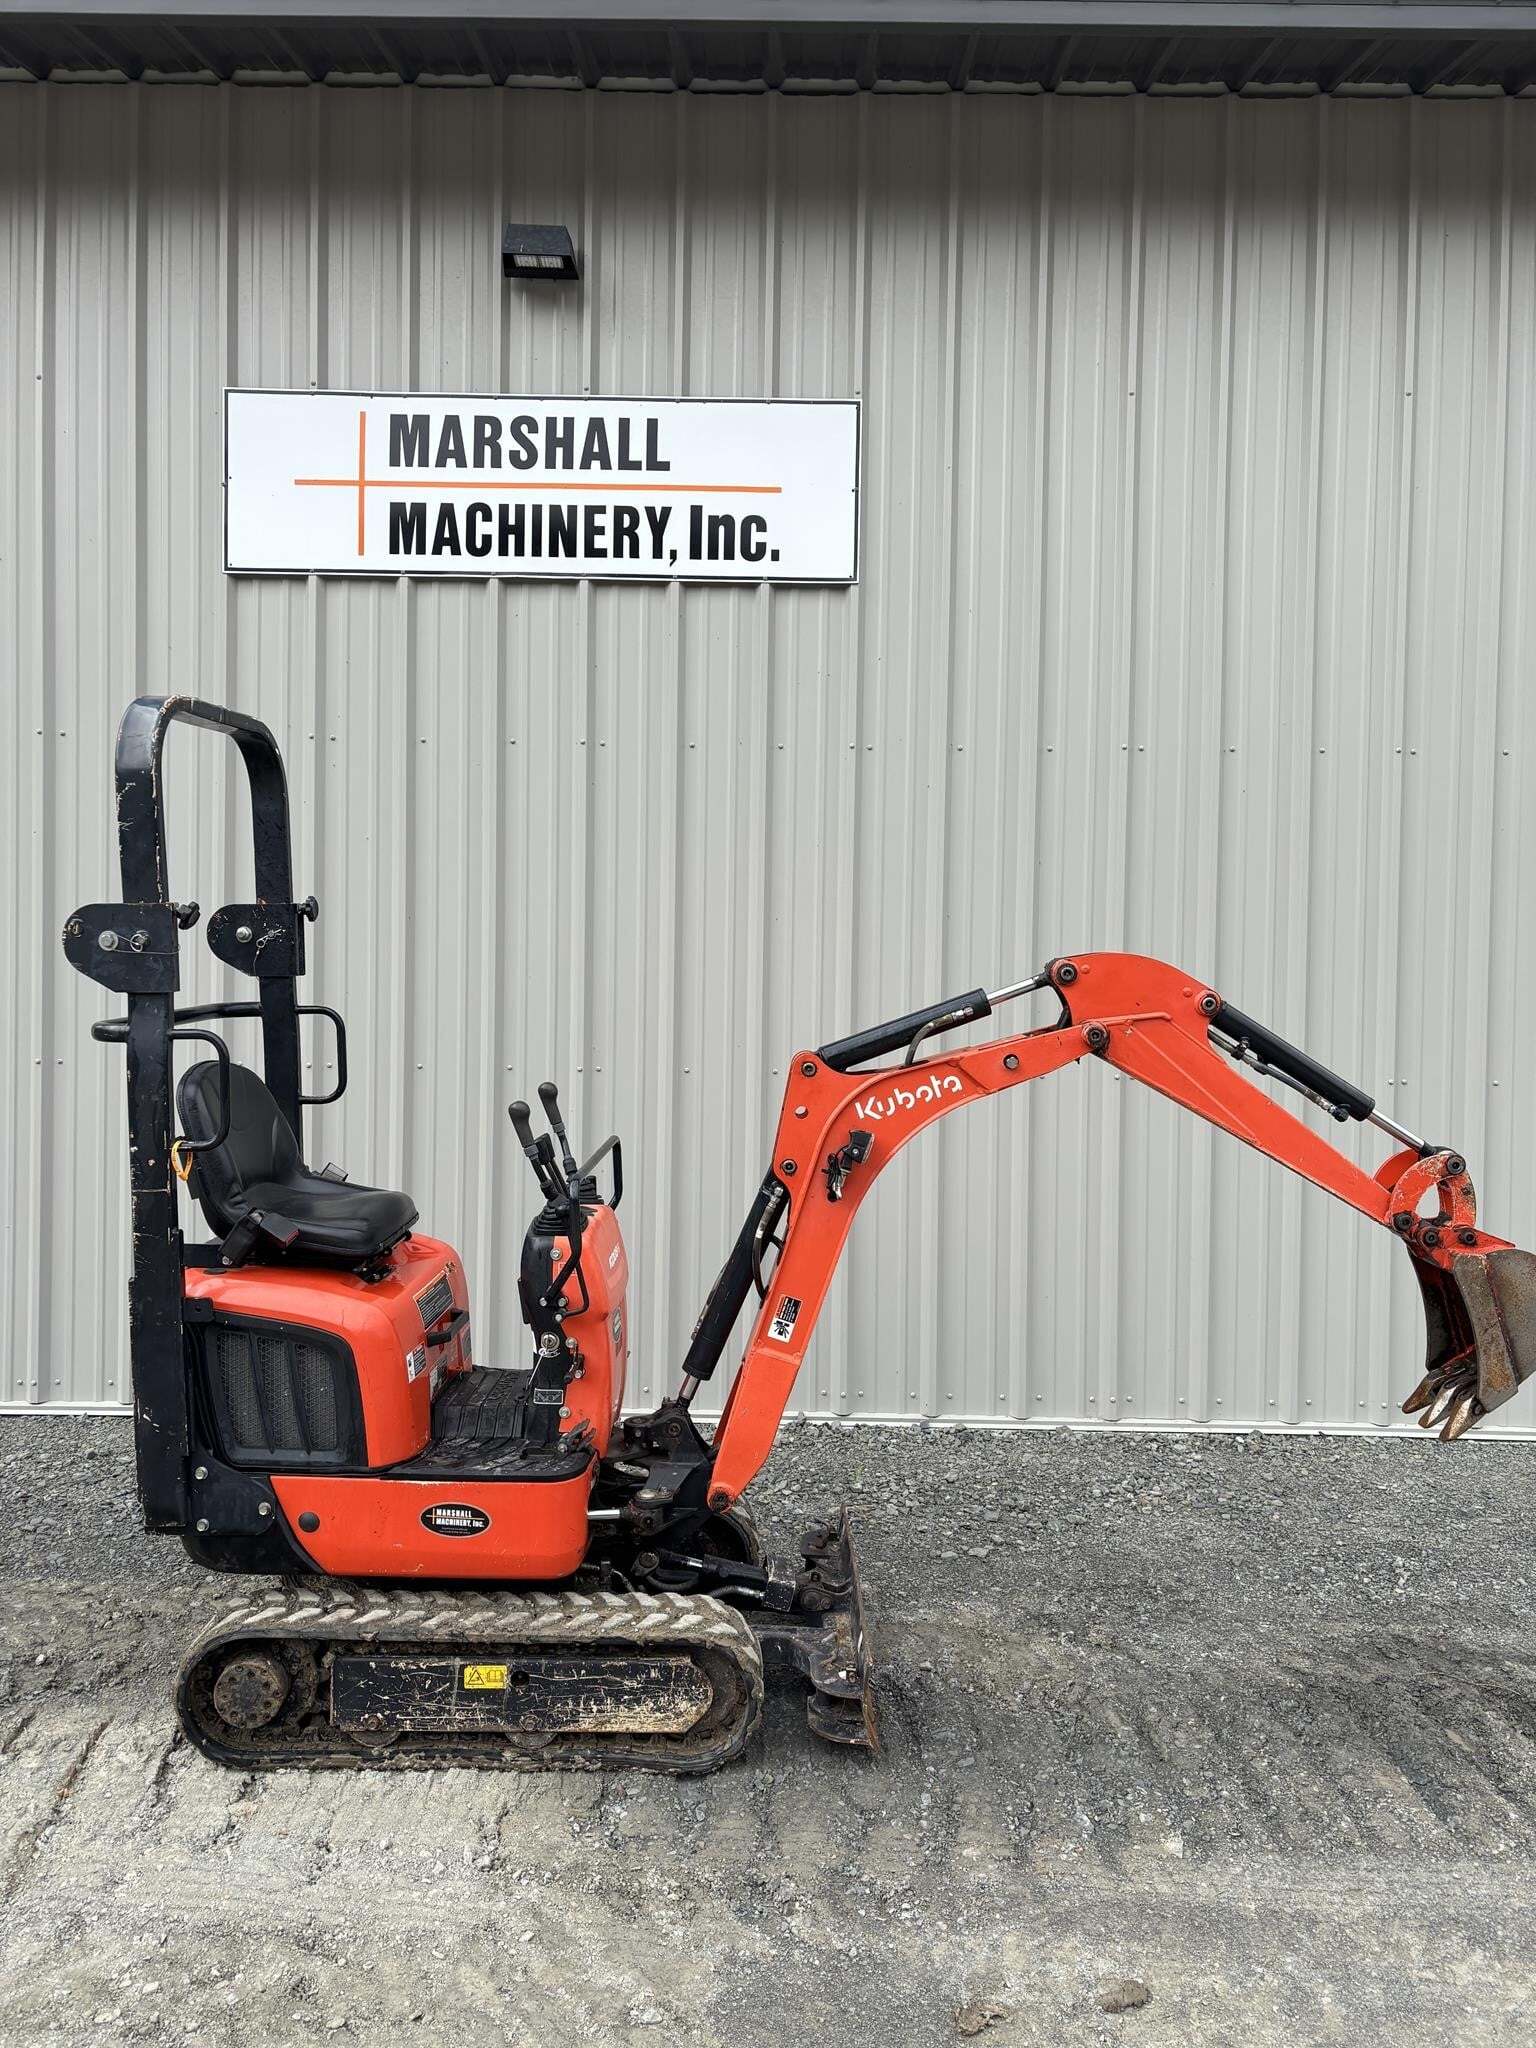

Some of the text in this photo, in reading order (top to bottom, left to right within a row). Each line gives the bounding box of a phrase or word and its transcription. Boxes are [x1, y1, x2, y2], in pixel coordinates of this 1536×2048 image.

[389, 414, 671, 471] MARSHALL
[389, 502, 780, 567] MACHINERY, Inc.
[854, 1074, 963, 1120] Kubota
[436, 1508, 472, 1518] MARSHALL
